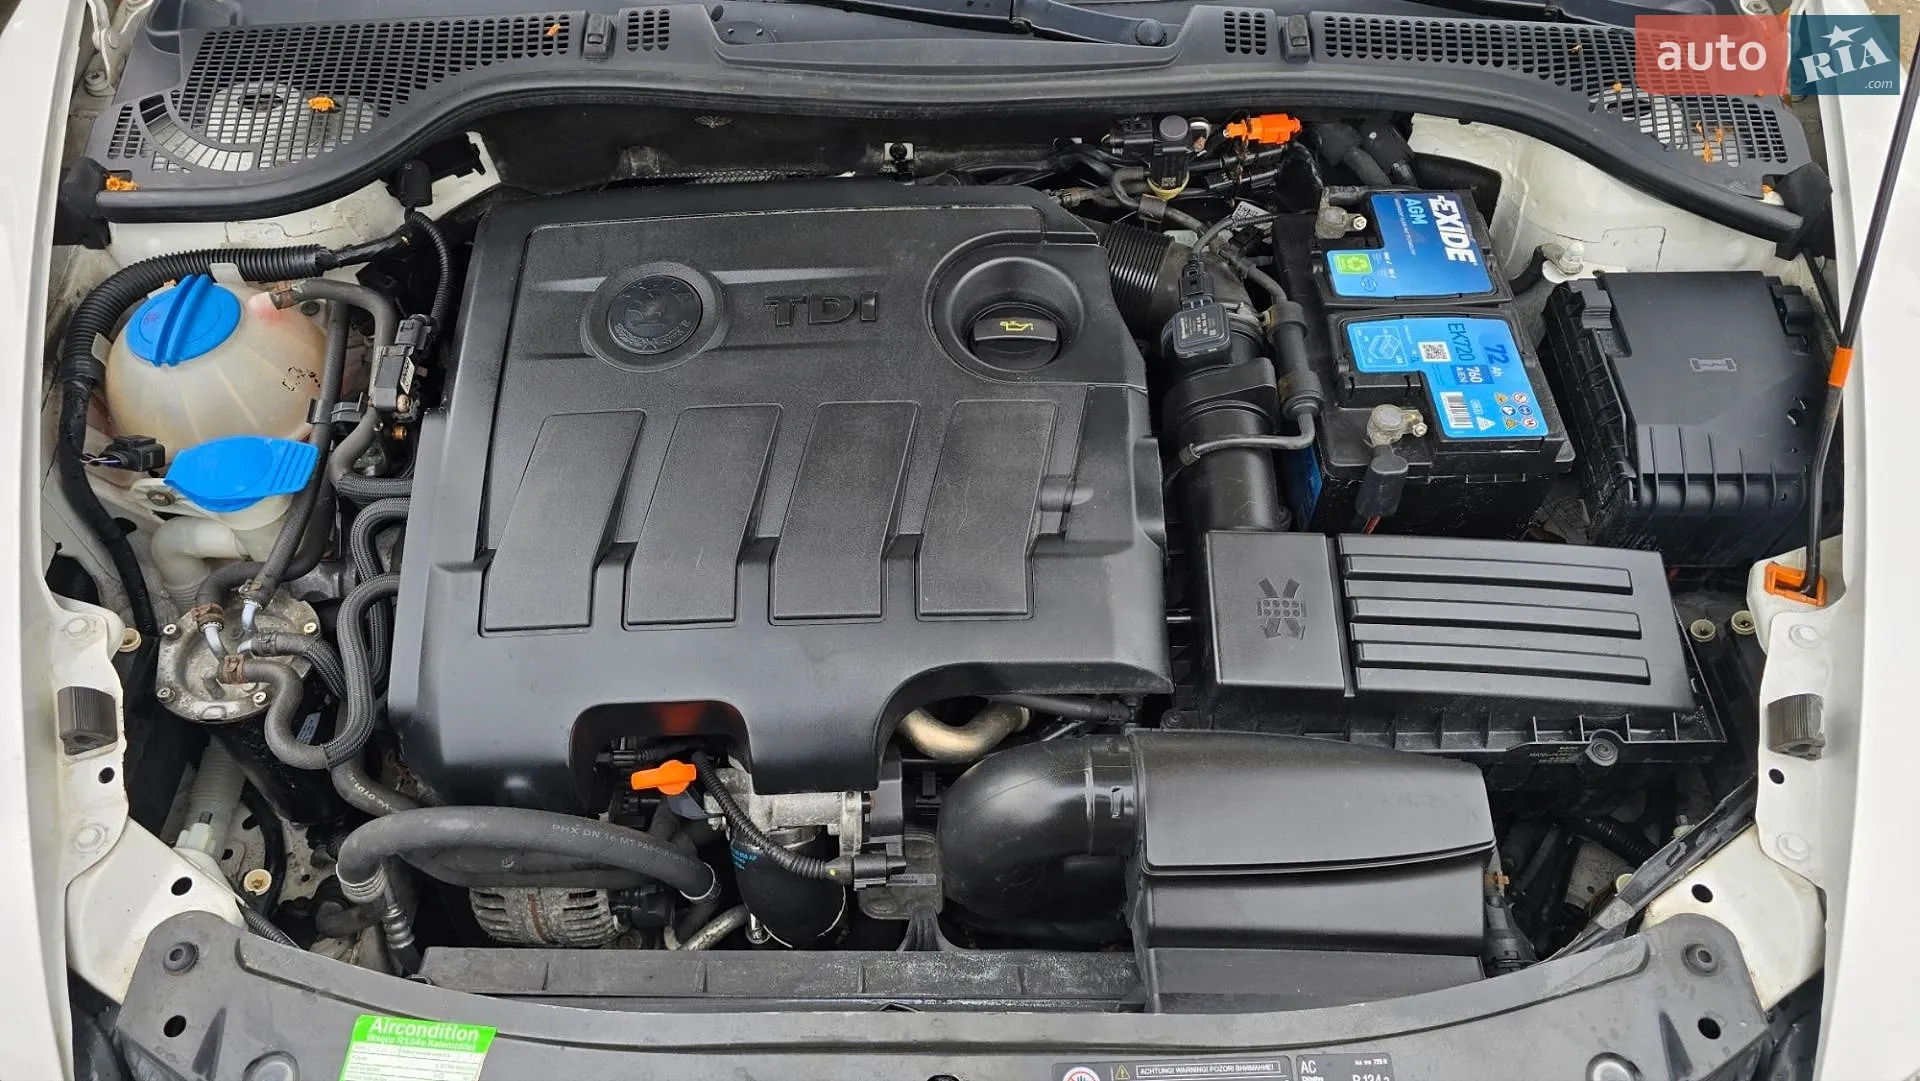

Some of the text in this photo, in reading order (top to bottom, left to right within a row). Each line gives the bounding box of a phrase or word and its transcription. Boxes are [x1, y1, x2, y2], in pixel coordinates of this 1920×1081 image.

[1404, 197, 1429, 226] AGM
[1428, 194, 1478, 266] EXIDE
[764, 290, 879, 326] TDI
[1447, 322, 1476, 362] EK720
[1483, 343, 1510, 365] 72
[1467, 366, 1484, 384] 760
[369, 1017, 480, 1041] Aircondition
[1300, 1060, 1317, 1074] AC
